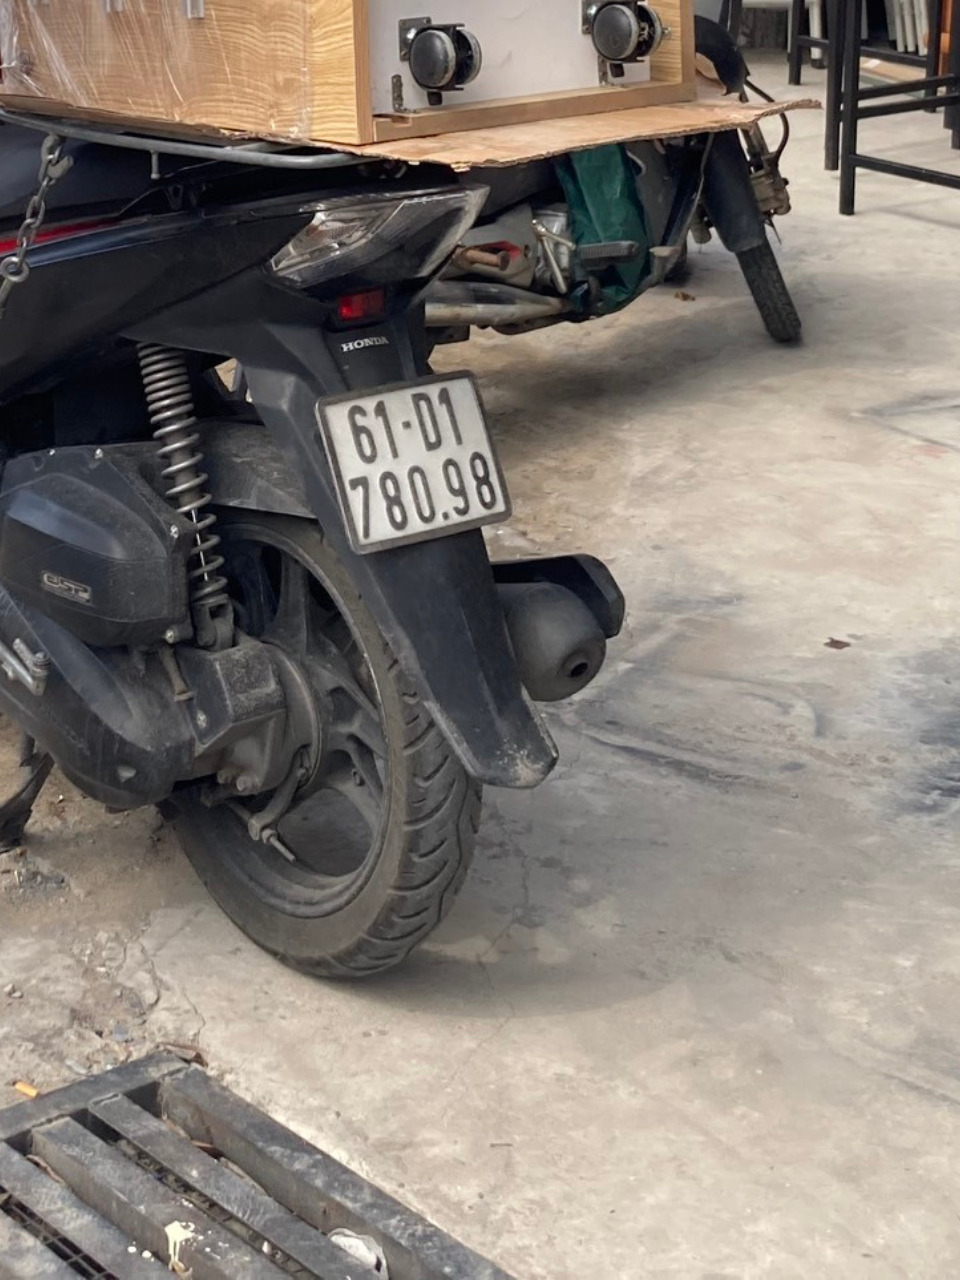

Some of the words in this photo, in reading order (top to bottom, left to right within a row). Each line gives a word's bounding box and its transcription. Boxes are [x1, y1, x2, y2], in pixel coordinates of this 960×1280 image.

[341, 335, 390, 353] HONDA
[347, 387, 462, 465] 61-D1
[349, 451, 496, 539] 780.98
